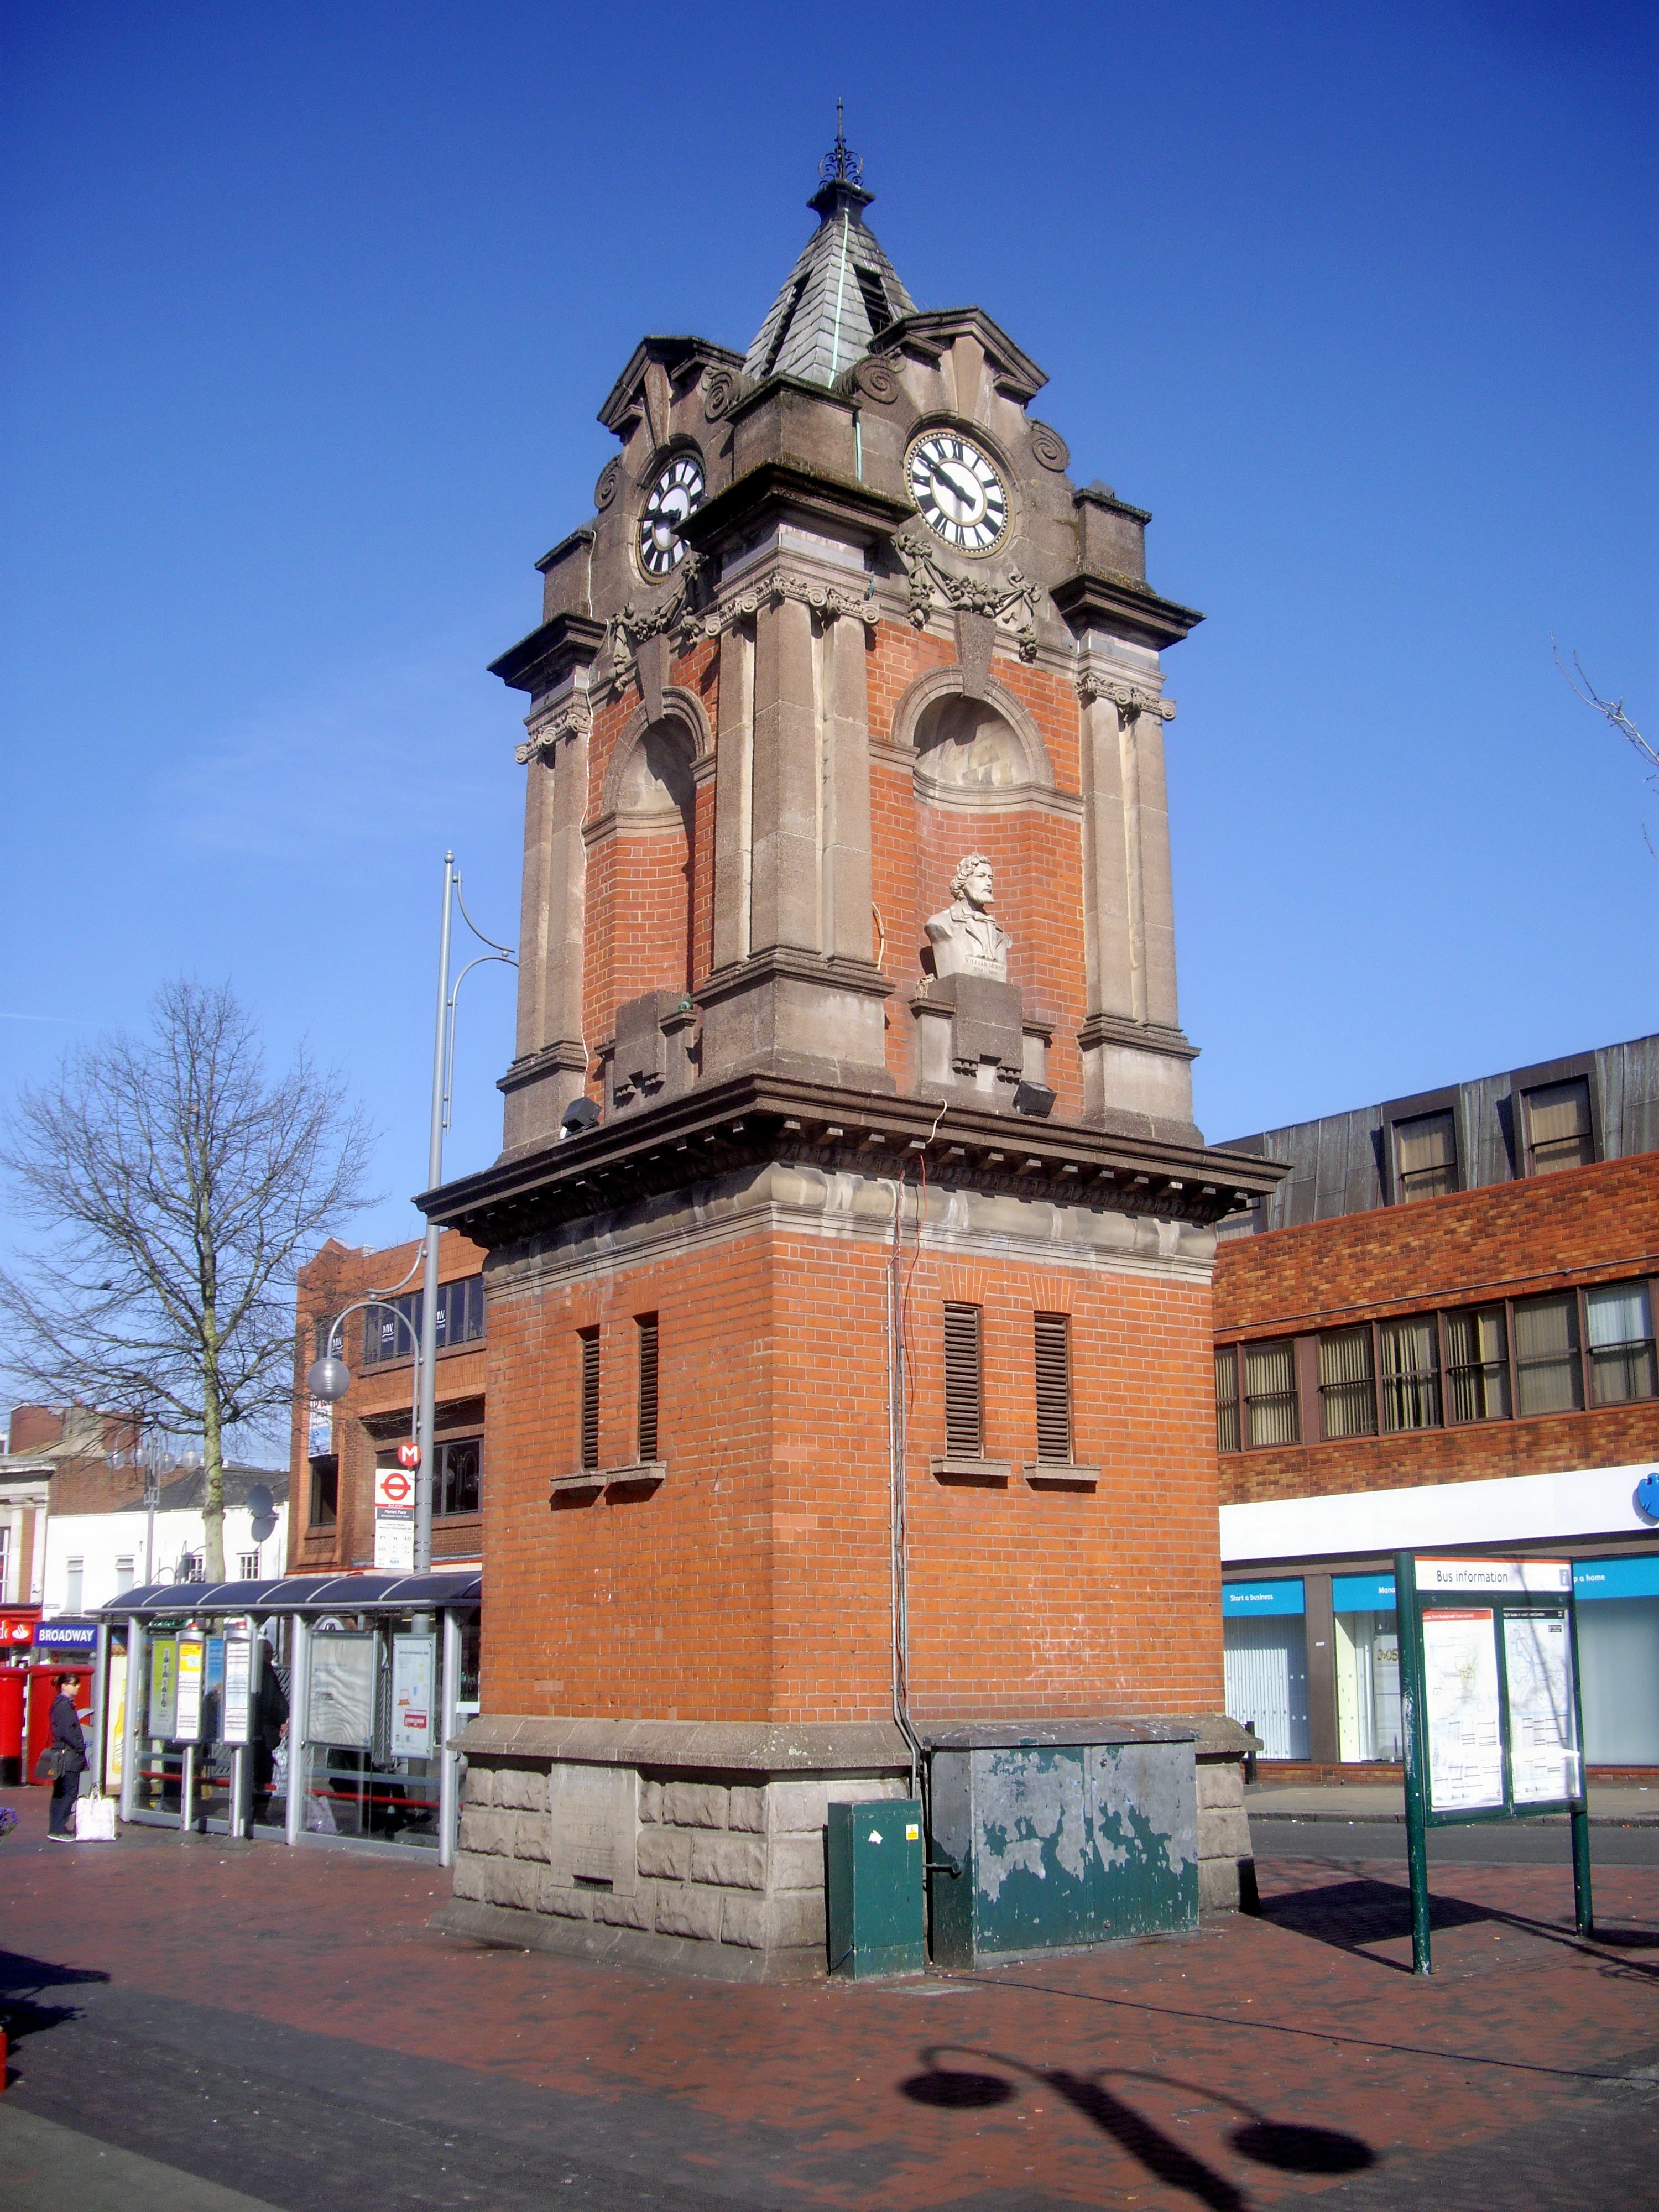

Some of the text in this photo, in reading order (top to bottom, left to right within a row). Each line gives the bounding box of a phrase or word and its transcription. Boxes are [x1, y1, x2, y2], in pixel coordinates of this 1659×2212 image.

[401, 1445, 418, 1462] M
[1437, 1569, 1508, 1582] Bus information
[39, 1629, 95, 1642] BROADWAY
